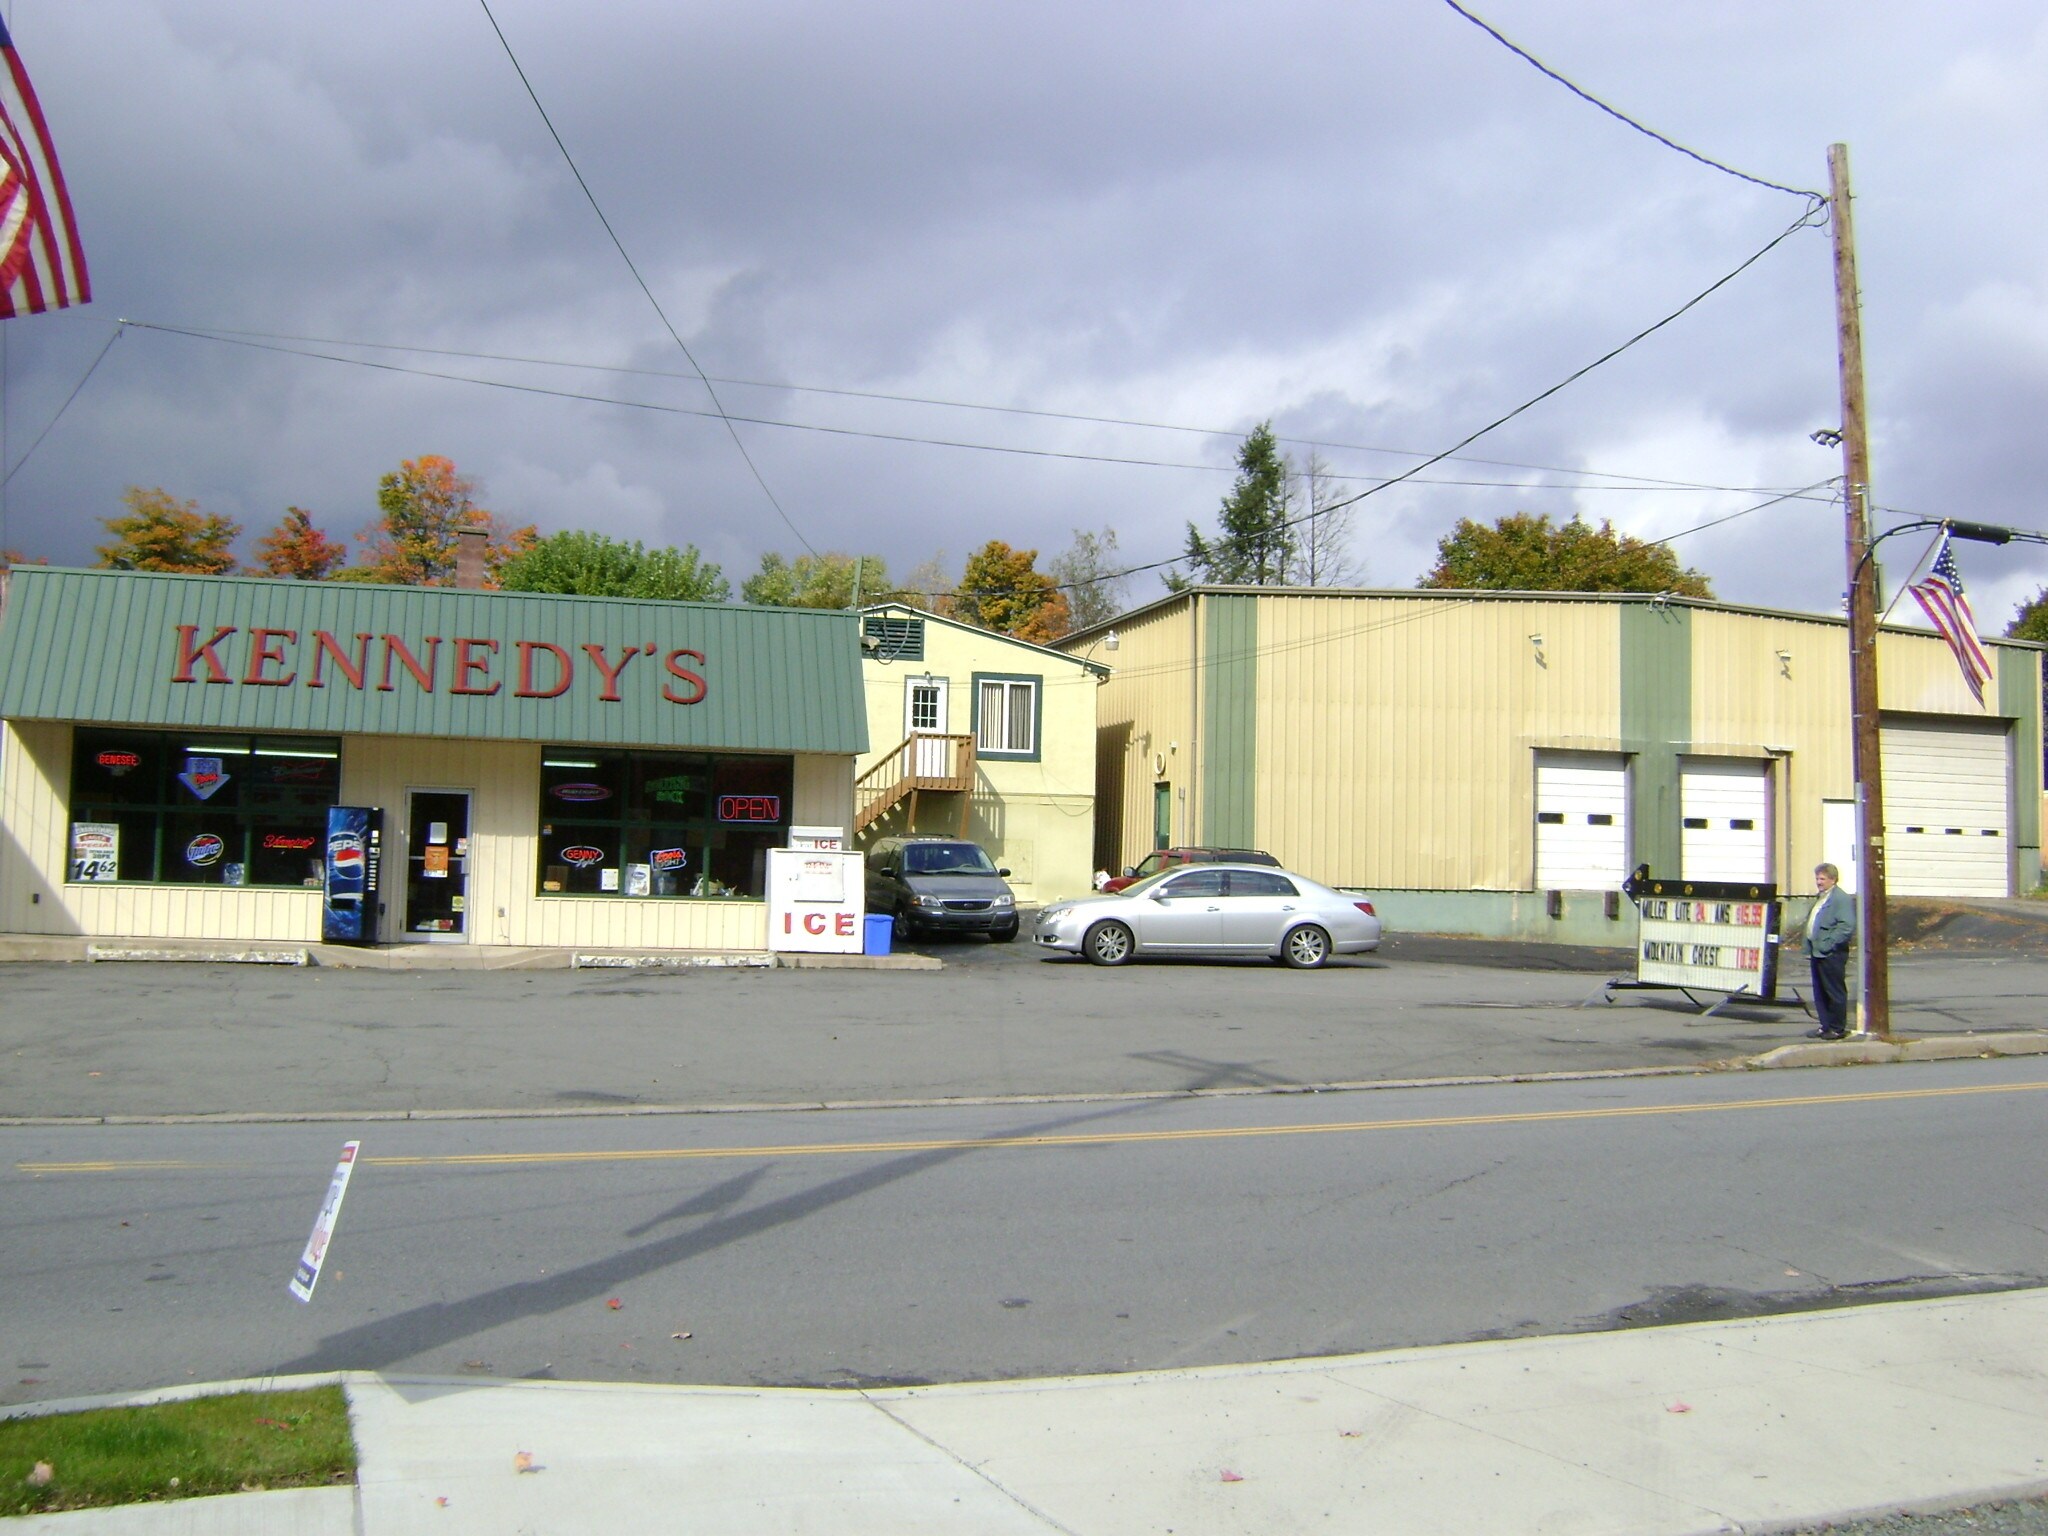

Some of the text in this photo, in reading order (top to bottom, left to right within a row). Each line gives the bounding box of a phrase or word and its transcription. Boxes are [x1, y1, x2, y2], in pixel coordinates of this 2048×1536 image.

[172, 624, 707, 704] KENNEDY'S
[99, 754, 138, 767] GENESEE
[721, 798, 779, 819] OPEN
[565, 849, 599, 860] GENNY
[814, 839, 838, 850] ICE
[1642, 900, 1667, 919] MILLER
[1675, 902, 1691, 921] LITE
[784, 912, 855, 936] ICE
[1644, 941, 1683, 962] MOUNTAIN
[1692, 945, 1720, 966] CREST
